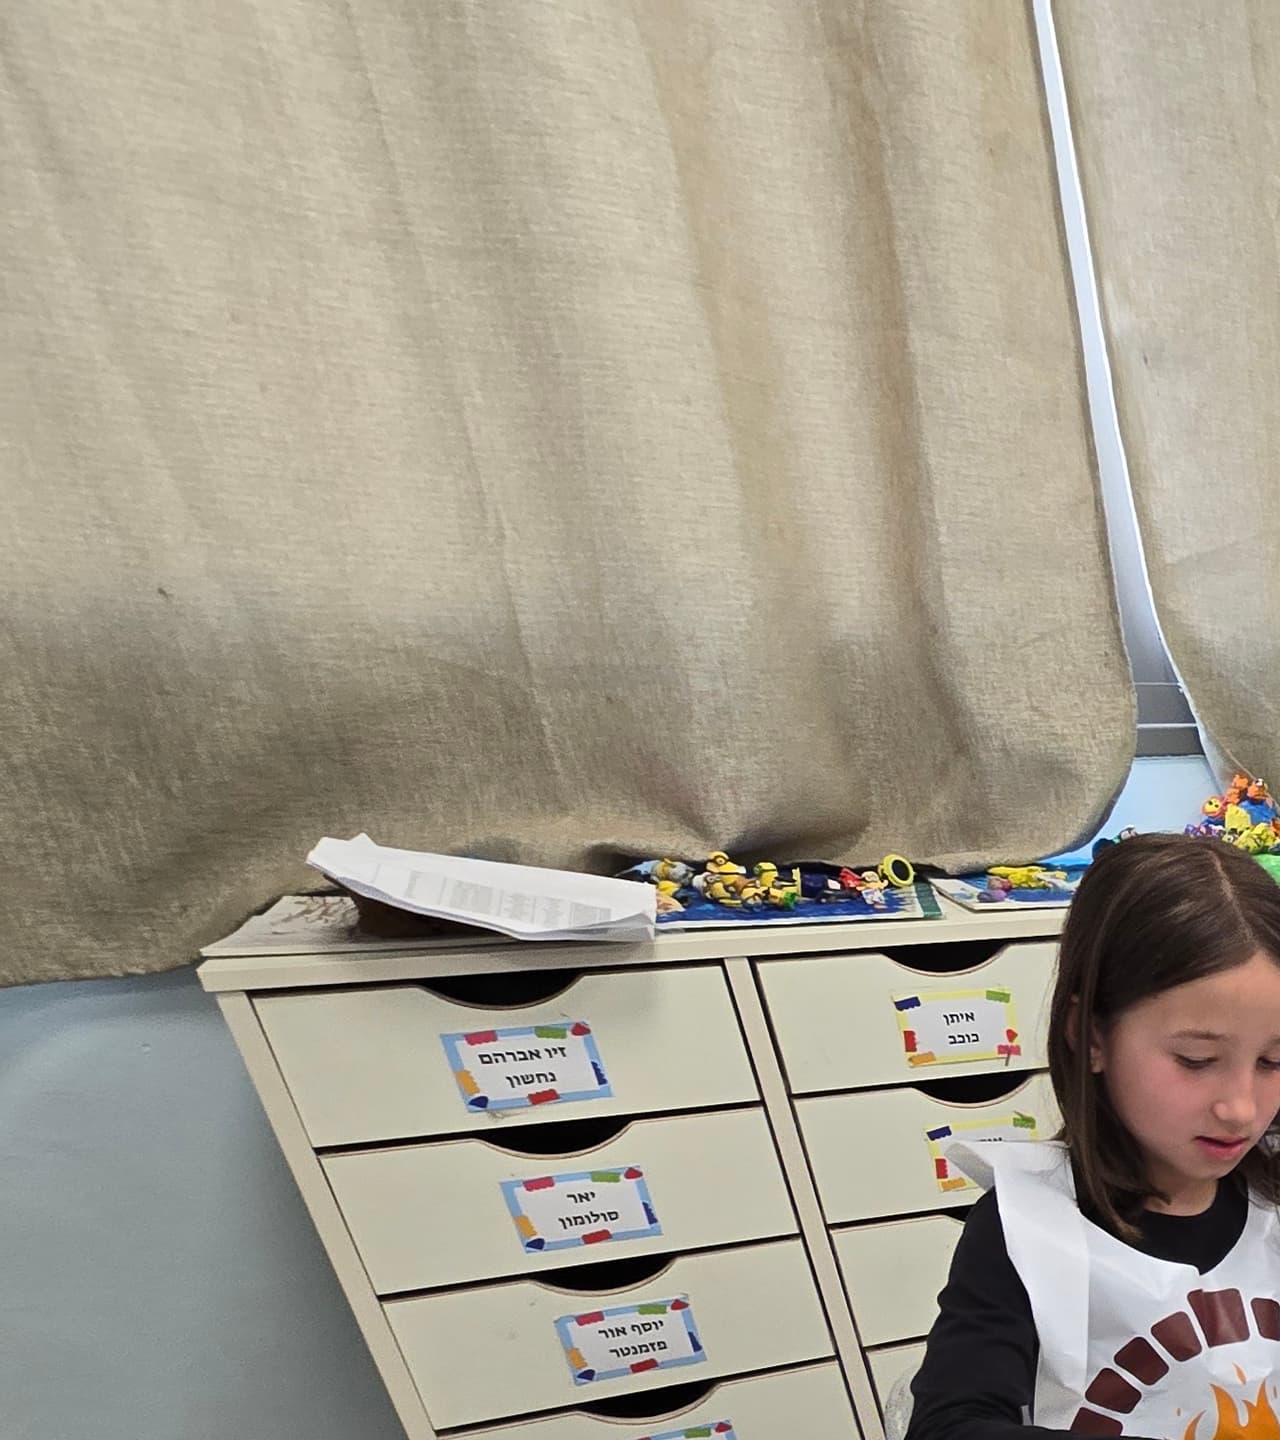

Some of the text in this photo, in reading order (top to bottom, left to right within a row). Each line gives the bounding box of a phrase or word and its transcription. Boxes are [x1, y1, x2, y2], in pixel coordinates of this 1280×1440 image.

[942, 1011, 976, 1026] איתן
[948, 1033, 980, 1045] כוכב
[478, 1044, 567, 1065] זיו אברהם
[505, 1071, 557, 1089] נחשון
[566, 1191, 596, 1204] יאר
[558, 1211, 619, 1230] סולומון
[598, 1319, 664, 1339] יוסף אור
[608, 1340, 668, 1358] פזמנטר
